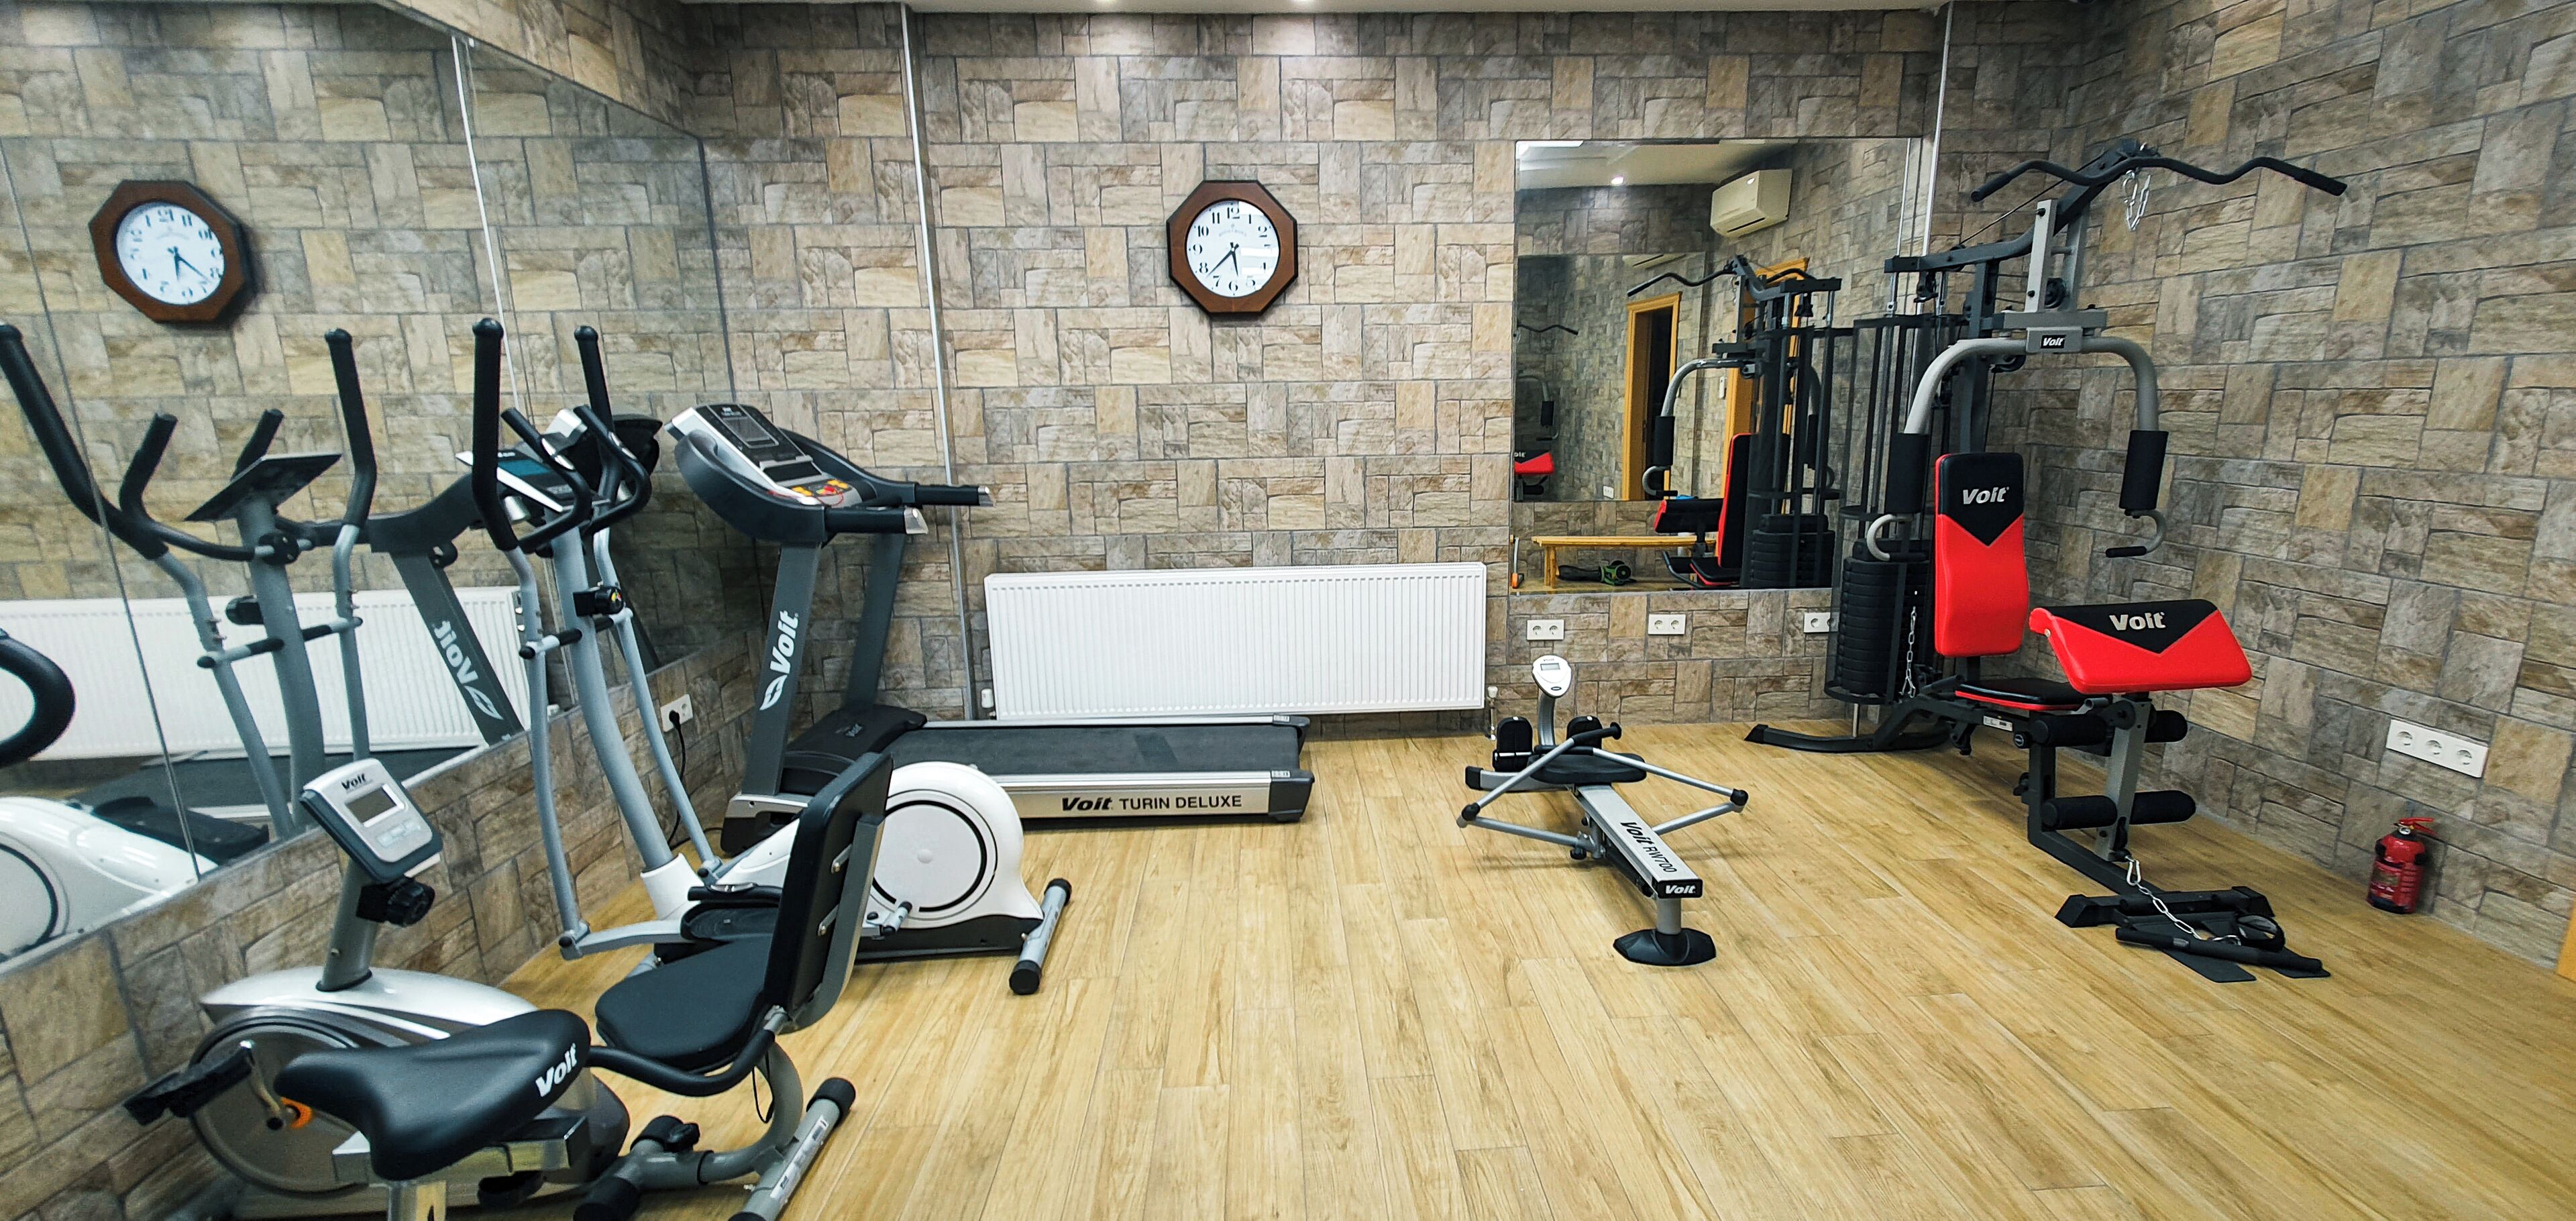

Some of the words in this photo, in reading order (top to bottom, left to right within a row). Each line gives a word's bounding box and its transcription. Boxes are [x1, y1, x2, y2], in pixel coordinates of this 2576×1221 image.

[1212, 212, 1220, 224] 11
[1227, 207, 1240, 219] 12
[1248, 214, 1252, 224] 1
[1197, 225, 1210, 237] 10
[1258, 225, 1268, 237] 2
[1193, 244, 1203, 256] 9
[1199, 262, 1208, 274] 8
[1213, 275, 1221, 287] 7
[1228, 280, 1238, 292] 6
[2043, 337, 2064, 346] Voit
[1962, 486, 2009, 505] Voit
[2108, 612, 2166, 631] Voit
[769, 610, 798, 674] Voit
[341, 774, 366, 790] Voit
[1062, 797, 1113, 811] Voit
[1119, 797, 1170, 810] TURIN
[1175, 795, 1242, 809] DELUXE
[1620, 822, 1654, 845] Voit
[1642, 846, 1678, 872] RW700
[1665, 885, 1696, 894] Voit
[535, 1043, 578, 1098] Voit
